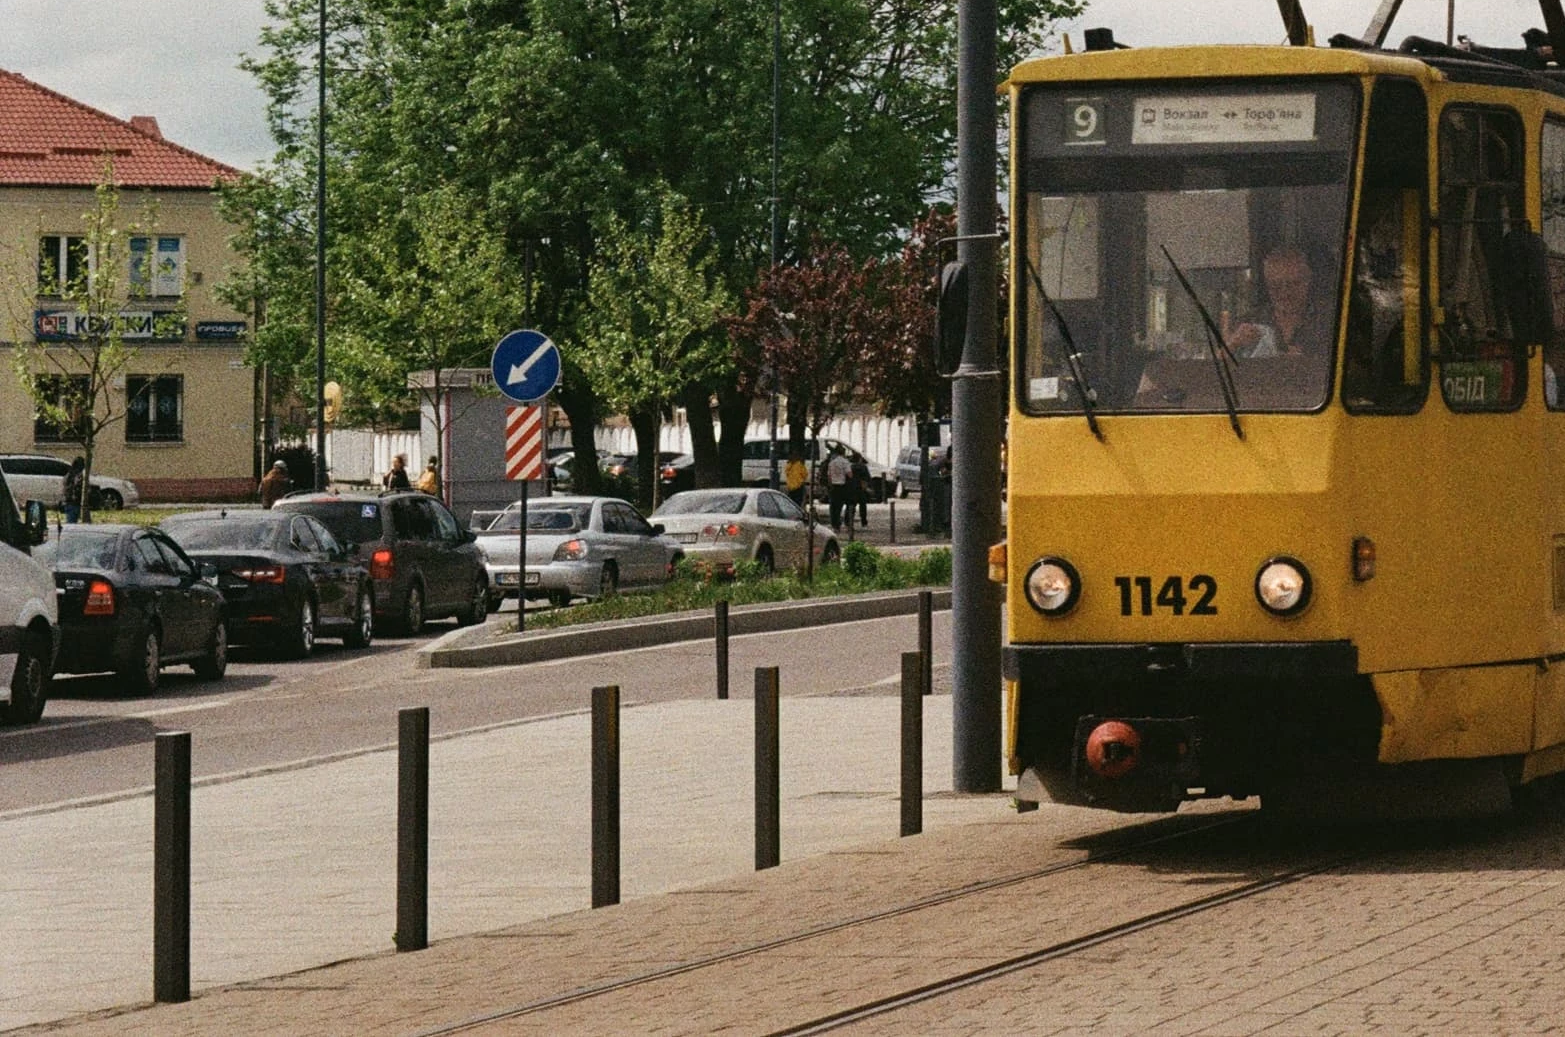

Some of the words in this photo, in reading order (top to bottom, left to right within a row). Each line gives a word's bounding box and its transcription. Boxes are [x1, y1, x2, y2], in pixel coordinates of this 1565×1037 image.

[1074, 105, 1097, 137] 9
[1163, 108, 1209, 120] Вокзал
[1114, 574, 1218, 616] 1142
